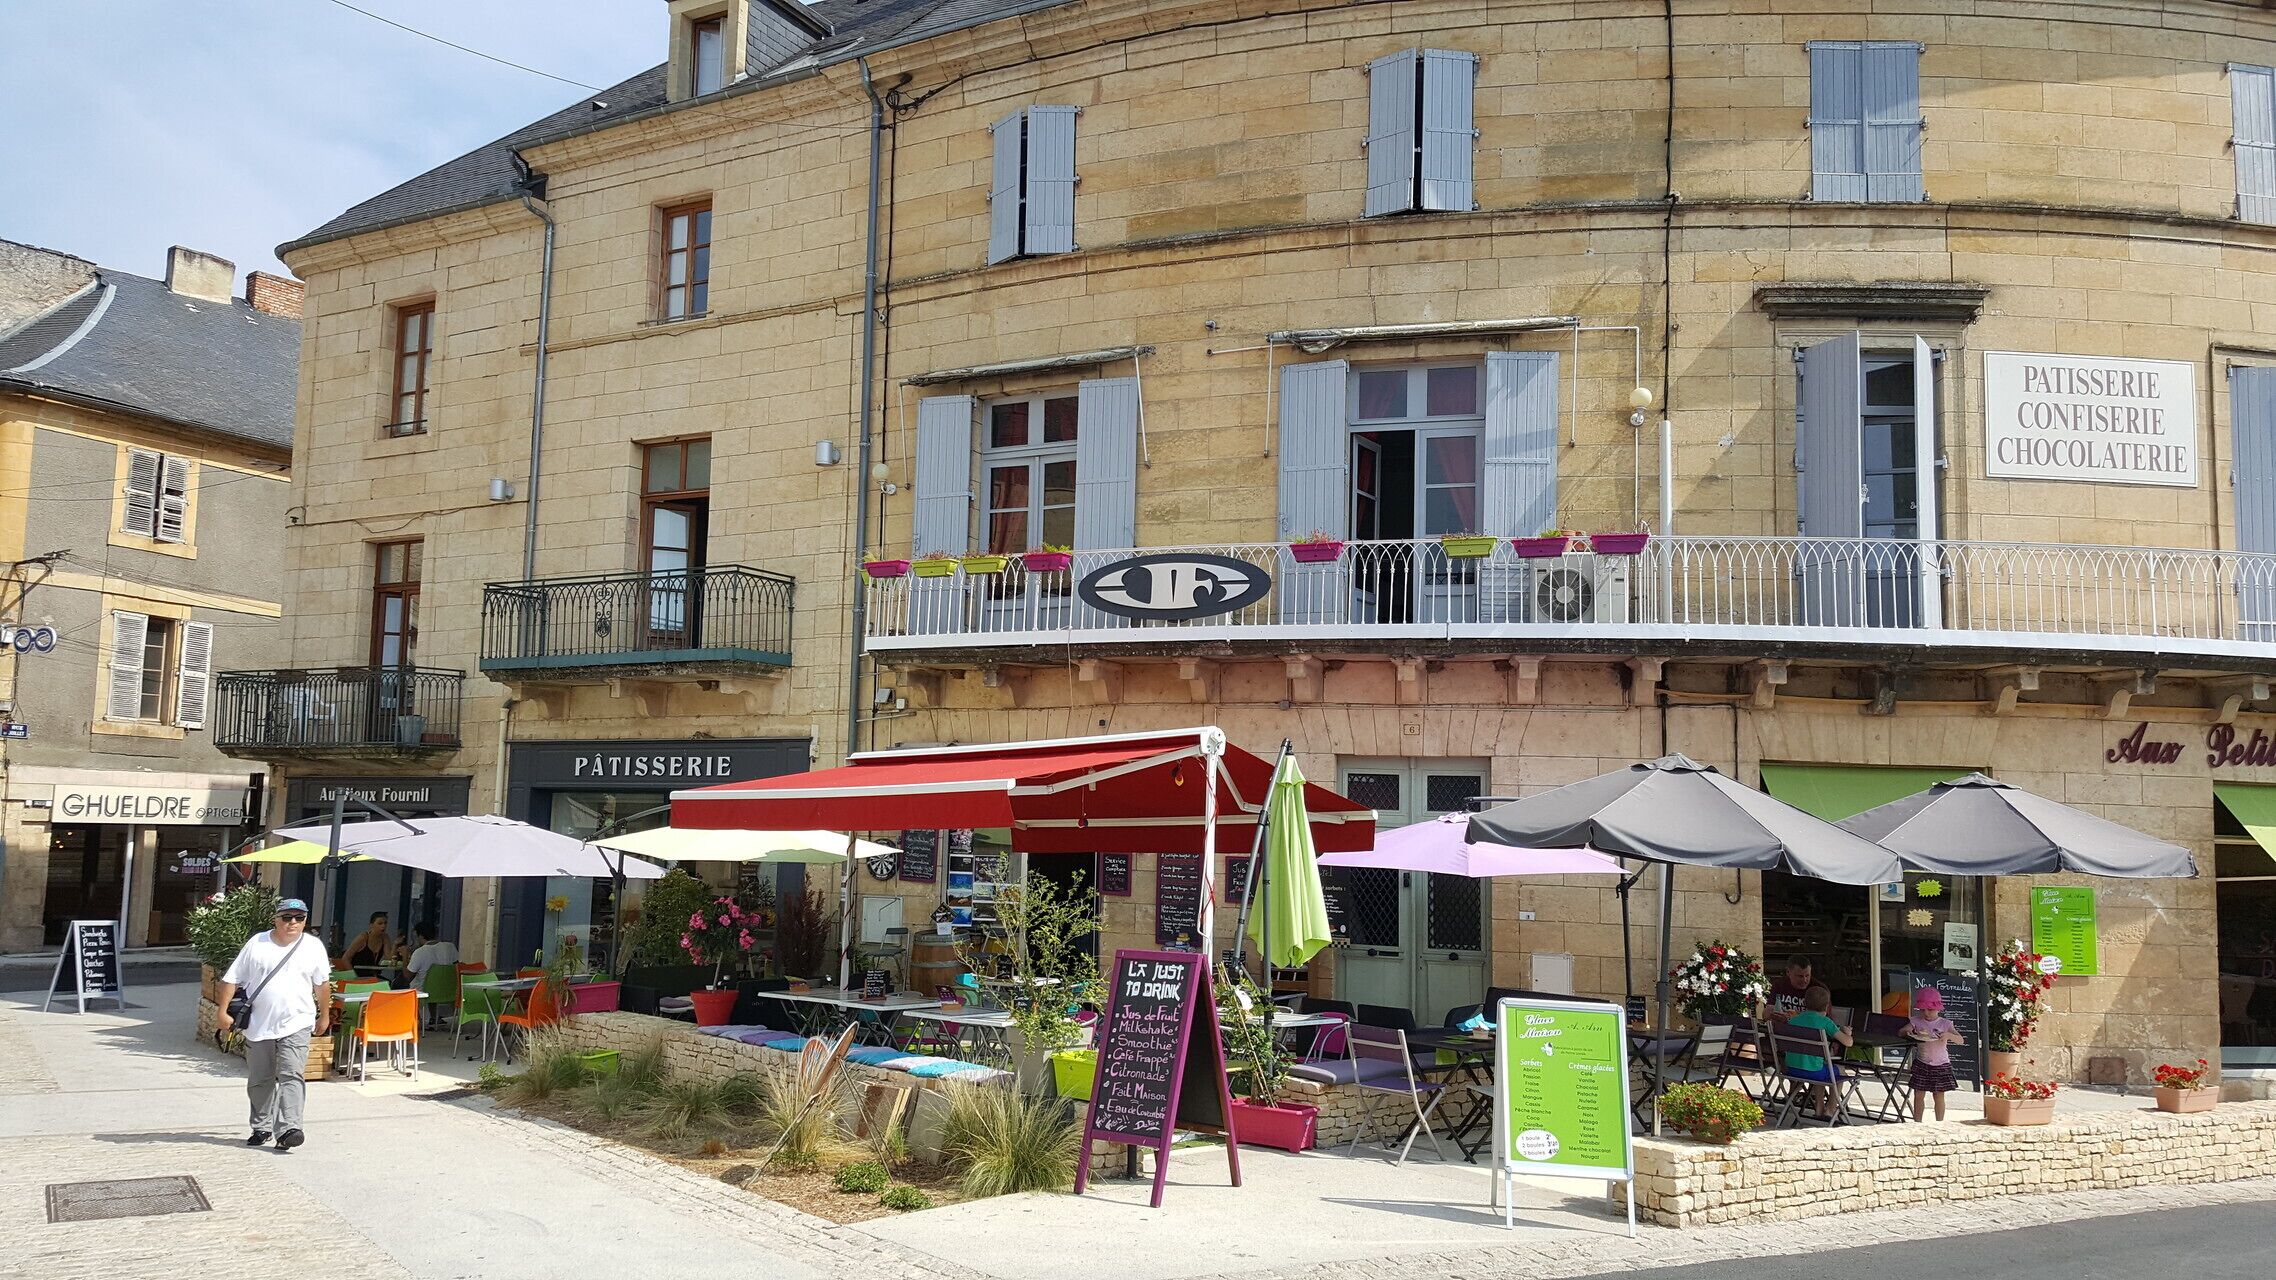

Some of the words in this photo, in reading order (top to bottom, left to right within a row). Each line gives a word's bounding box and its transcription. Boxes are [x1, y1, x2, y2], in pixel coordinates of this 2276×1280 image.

[2023, 365, 2161, 399] PATISSERIE
[2017, 401, 2166, 436] CONFISERIE
[1997, 437, 2188, 473] CHOCOLATERIE
[1409, 725, 1415, 734] 6
[2105, 721, 2186, 764] Aux
[574, 752, 731, 777] PÂTISSERIE
[381, 787, 430, 802] Fournil
[62, 793, 191, 819] GHUELDRE
[182, 857, 211, 866] SOLDES
[1232, 862, 1247, 873] Jus
[1126, 980, 1141, 997] TO
[1142, 981, 1182, 1001] DRINK
[1936, 979, 1973, 993] Formules
[1781, 994, 1805, 1006] JACK
[1121, 1004, 1142, 1020] Jus
[1156, 1005, 1180, 1022] Fruit
[1119, 1020, 1174, 1036] Milkshake
[1117, 1034, 1172, 1051] Smoothie
[1112, 1047, 1134, 1061] Café
[1136, 1050, 1168, 1071] Frappé
[1520, 1058, 1543, 1067] Sorbets
[1568, 1062, 1592, 1070] Crèmes
[1592, 1063, 1615, 1073] glacées
[1110, 1062, 1165, 1081] Citronnade
[1112, 1081, 1132, 1098] Fait
[1106, 1098, 1126, 1112] Eau
